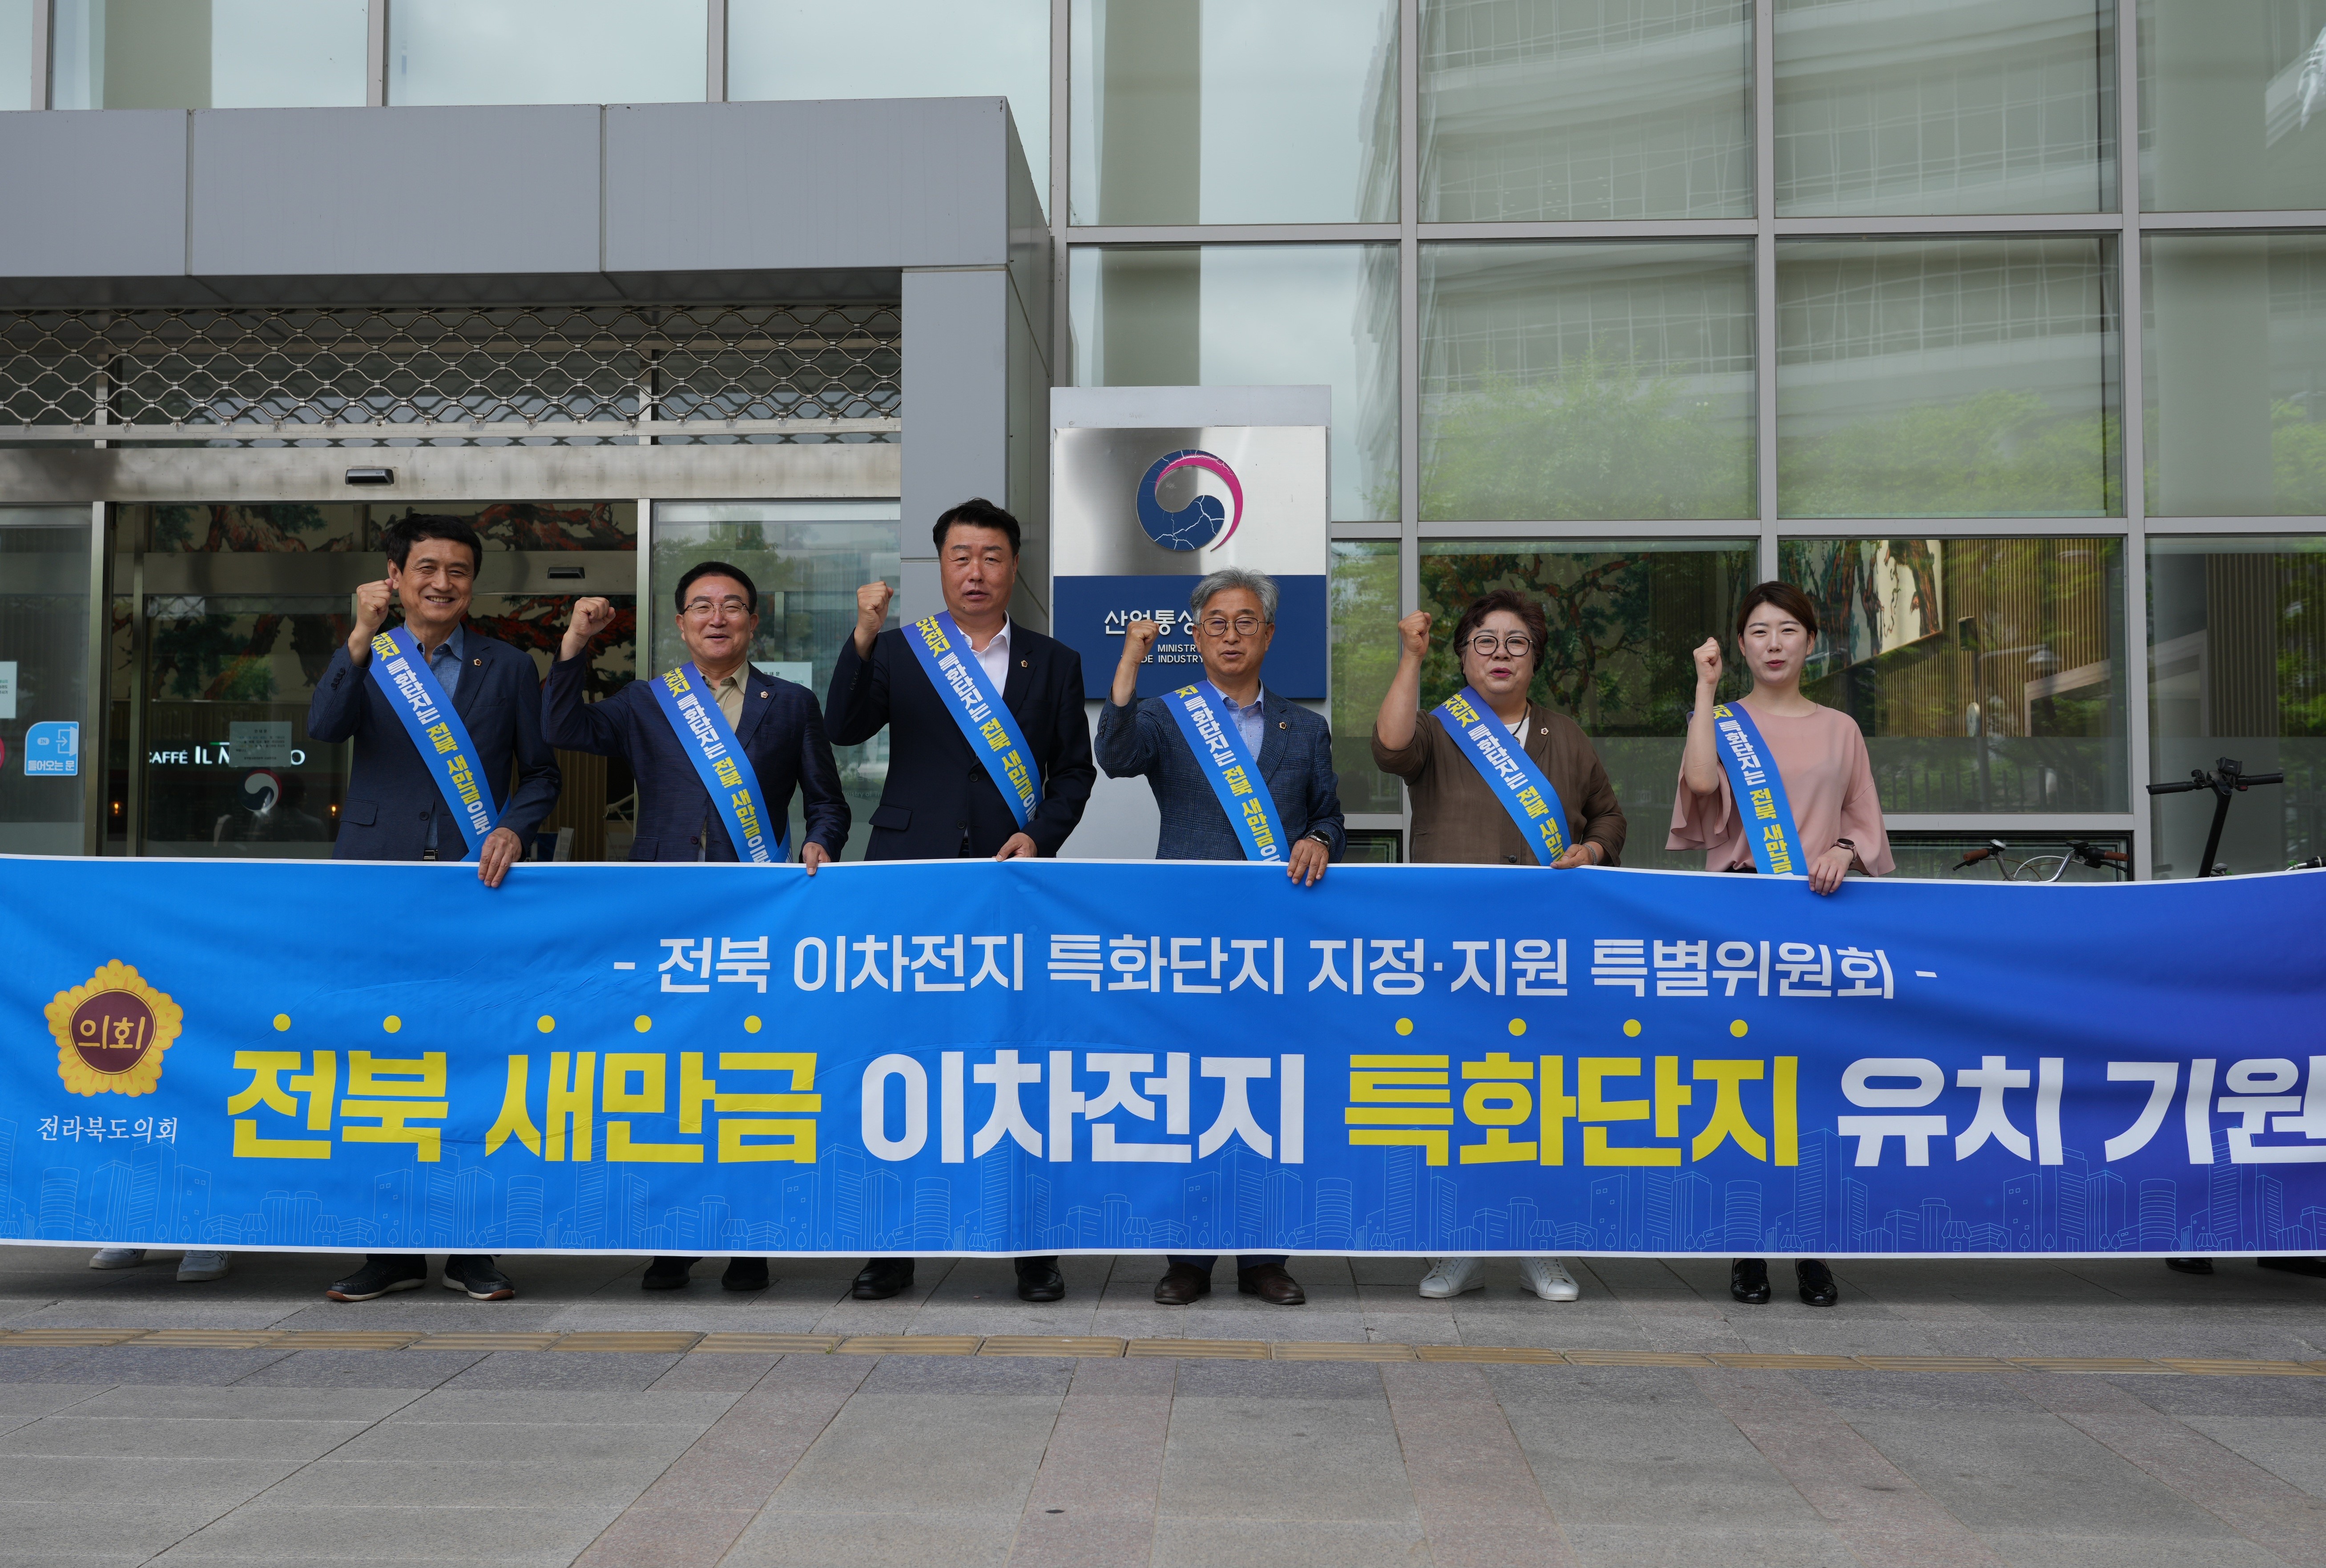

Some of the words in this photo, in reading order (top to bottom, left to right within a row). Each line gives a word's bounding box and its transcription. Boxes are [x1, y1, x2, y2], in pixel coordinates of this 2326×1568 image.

[1157, 644, 1196, 652] MINISTR
[386, 657, 440, 725] 특화단지는
[426, 722, 458, 754] 전북
[677, 693, 726, 760] 특화단지는
[713, 757, 742, 788] 전북
[938, 651, 992, 723] 특화단지는
[980, 717, 1011, 752] 전북
[28, 760, 63, 771] 들어오는
[65, 760, 74, 771] 문
[1184, 696, 1237, 767] 특화단지는
[1222, 765, 1253, 797] 전북
[1242, 799, 1283, 863] 새만금으
[1467, 723, 1528, 790] 특화단지는
[1516, 786, 1548, 819] 전북
[1718, 720, 1766, 786] 특화단지는
[1750, 788, 1777, 819] 전북
[658, 936, 770, 993] 전북
[794, 933, 1023, 992] 이차전지
[1048, 934, 1283, 994] 특화단지
[1309, 938, 1568, 996] 지정·지원
[1591, 939, 1894, 999] 특별위원회
[78, 1015, 146, 1050] 의회
[36, 1116, 177, 1144] 전라북도의회
[228, 1050, 448, 1162] 전북
[486, 1052, 821, 1163] 새만금
[862, 1050, 1304, 1164] 이차전지
[1346, 1053, 1798, 1166] 특화단지
[1838, 1056, 2064, 1167] 유치
[2104, 1055, 2326, 1165] 기원
